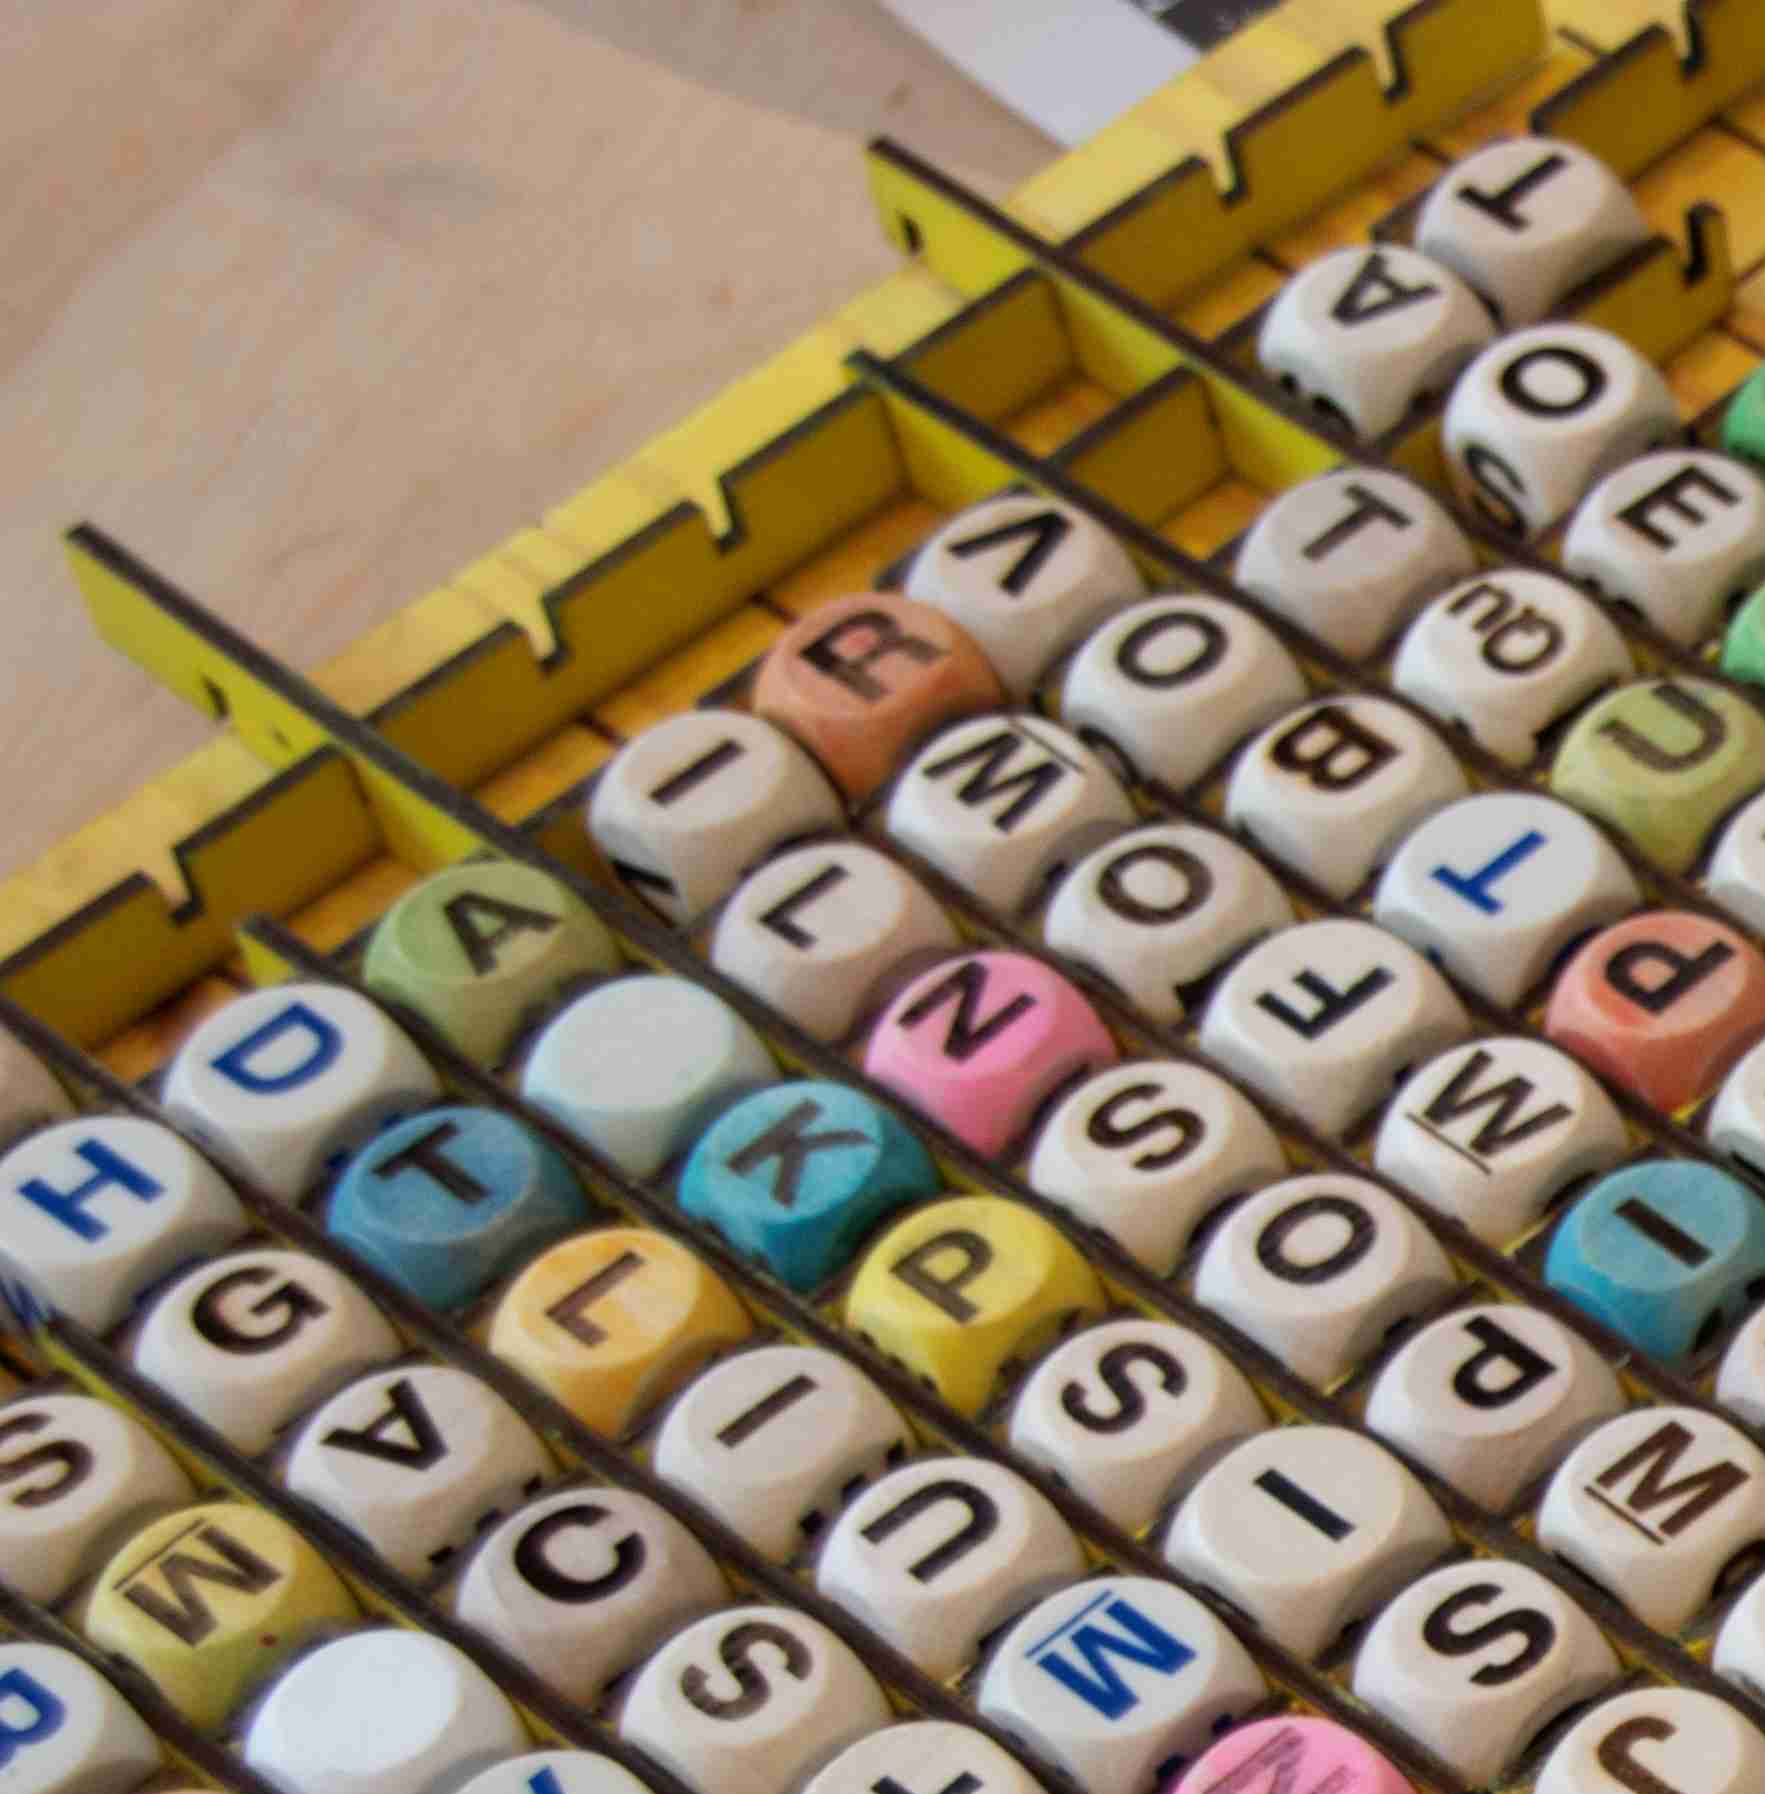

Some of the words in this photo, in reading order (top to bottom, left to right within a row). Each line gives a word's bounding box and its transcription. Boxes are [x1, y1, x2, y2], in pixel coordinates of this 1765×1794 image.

[1458, 154, 1566, 231] T
[1498, 346, 1607, 418] O
[1616, 465, 1738, 550] E
[949, 510, 1071, 595] V
[1115, 611, 1228, 688] O
[649, 739, 743, 805] I
[1273, 706, 1399, 793] B
[758, 865, 846, 949] L
[1432, 831, 1545, 914] T
[1256, 968, 1391, 1039] F
[211, 1003, 341, 1094] D
[1087, 1083, 1204, 1170] S
[18, 1140, 161, 1240] H
[1256, 1195, 1375, 1284] O
[191, 1267, 324, 1354] G
[1061, 1342, 1186, 1433] S
[1453, 1316, 1555, 1409] P
[323, 1380, 446, 1470] A
[717, 1375, 816, 1447] I
[861, 1480, 998, 1582] U
[1254, 1469, 1353, 1541] I
[513, 1505, 644, 1603] C
[681, 1622, 811, 1720] S
[1423, 1584, 1554, 1685] S
